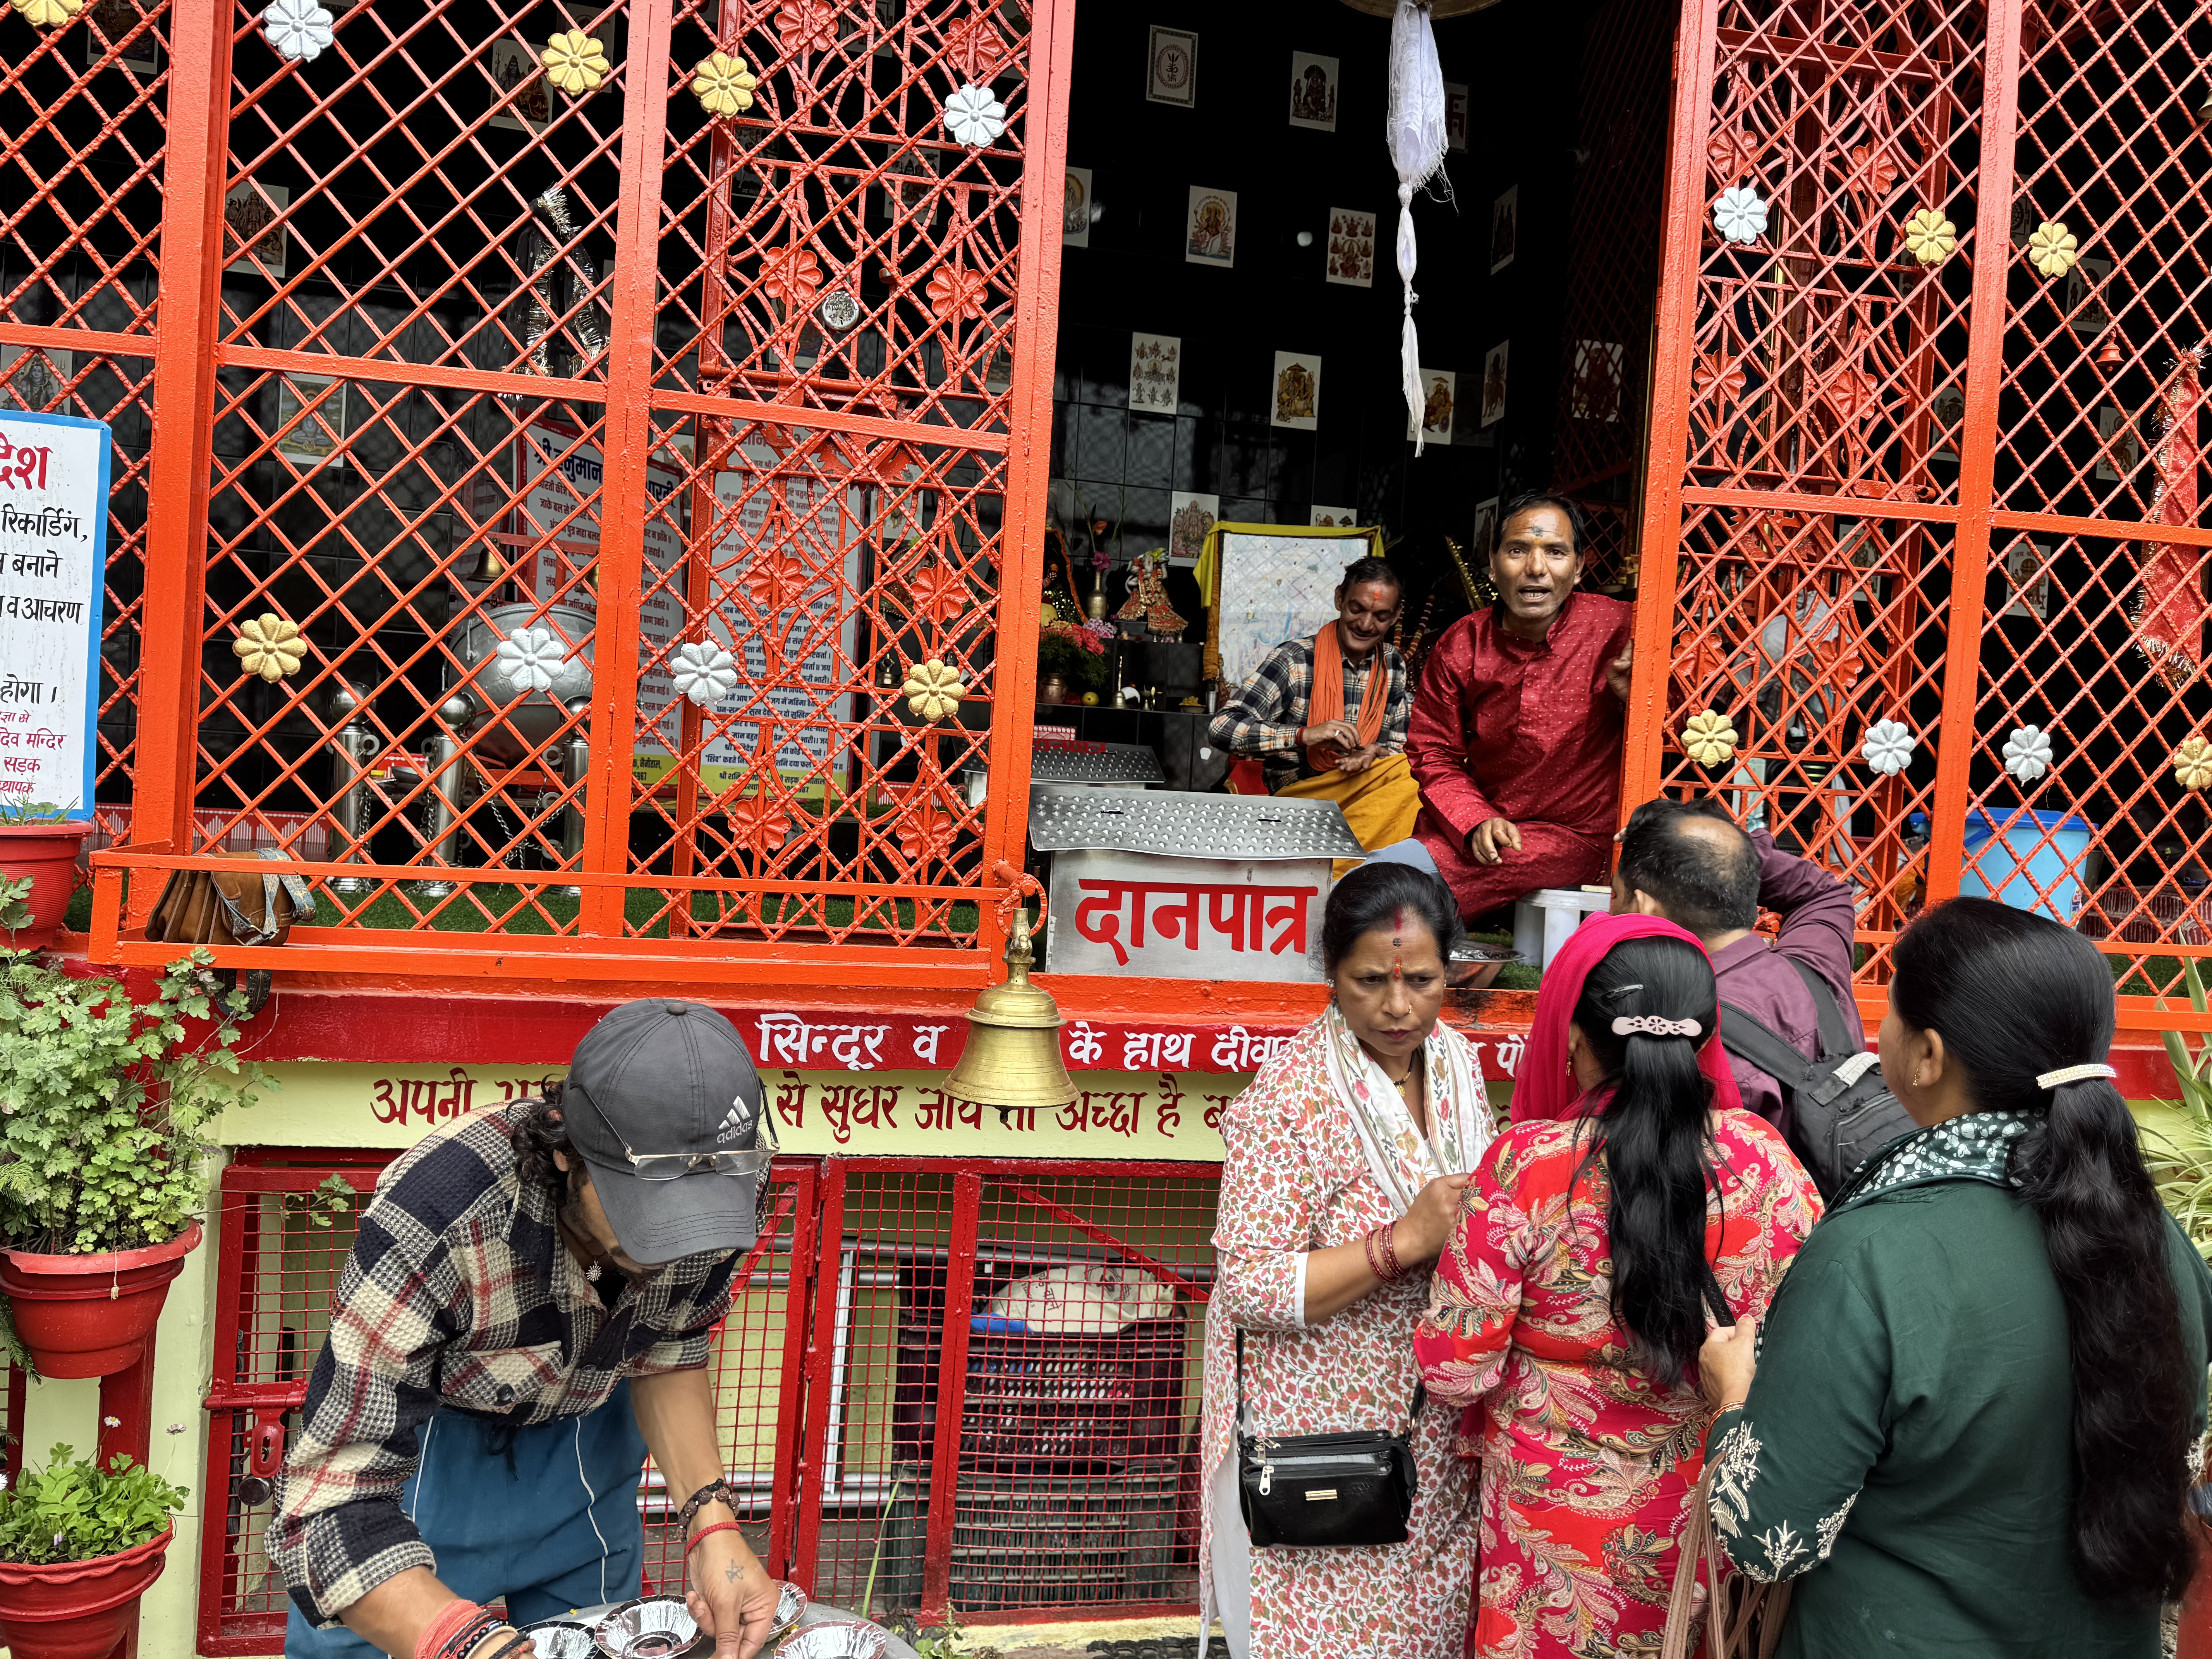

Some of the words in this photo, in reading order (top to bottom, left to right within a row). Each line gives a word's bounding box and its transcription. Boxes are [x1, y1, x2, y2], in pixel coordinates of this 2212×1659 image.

[539, 497, 552, 510] जाके
[553, 502, 563, 513] बल
[564, 503, 569, 515] से
[576, 527, 586, 539] महा
[720, 543, 734, 551] लोहा
[12, 549, 64, 579] बनाने
[7, 596, 21, 618] व
[21, 598, 84, 624] आचरण
[733, 619, 746, 627] सभी
[0, 673, 44, 704] होगा
[788, 697, 806, 706] महिमा
[19, 709, 31, 723] से
[26, 728, 67, 750] मन्दिर
[4, 756, 42, 776] सड़क
[640, 757, 662, 769] नैनीताल,
[723, 755, 736, 763] कहते
[1075, 878, 1318, 966] दानपात्र
[754, 1013, 892, 1072] सिन्दूर
[912, 1025, 950, 1064] व
[1068, 1021, 1108, 1064] के
[1123, 1032, 1197, 1071] हाथ
[370, 1067, 478, 1126] अपनी
[776, 1070, 812, 1128] से
[820, 1083, 905, 1144] सुधर
[1157, 1073, 1187, 1138] है
[717, 1120, 753, 1144] adidas
